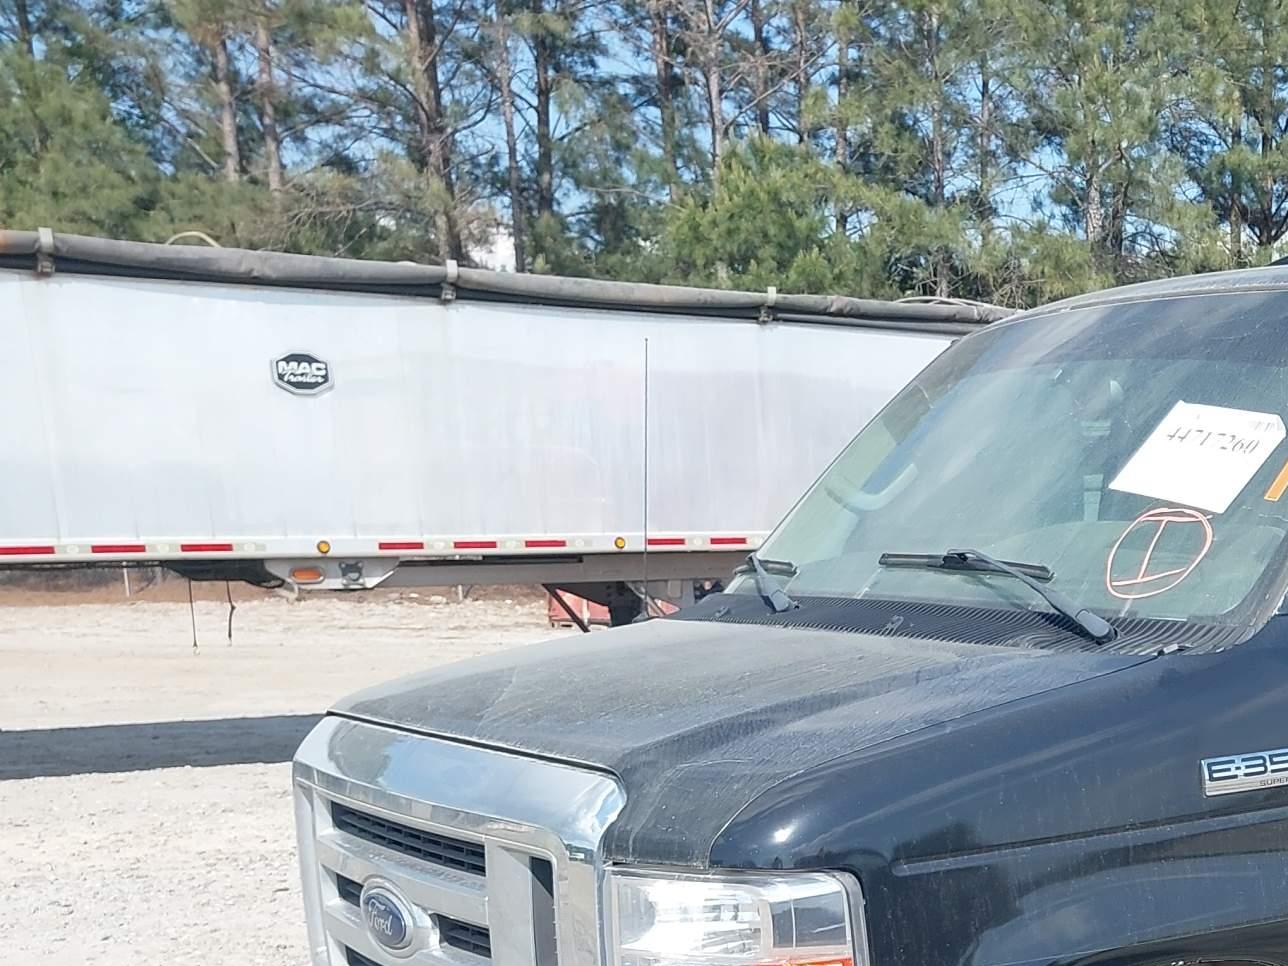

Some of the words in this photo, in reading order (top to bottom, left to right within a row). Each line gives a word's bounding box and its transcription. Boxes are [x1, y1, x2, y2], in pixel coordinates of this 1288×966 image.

[277, 361, 327, 376] MAC
[1166, 426, 1260, 454] 44717260
[368, 898, 393, 936] Ford
